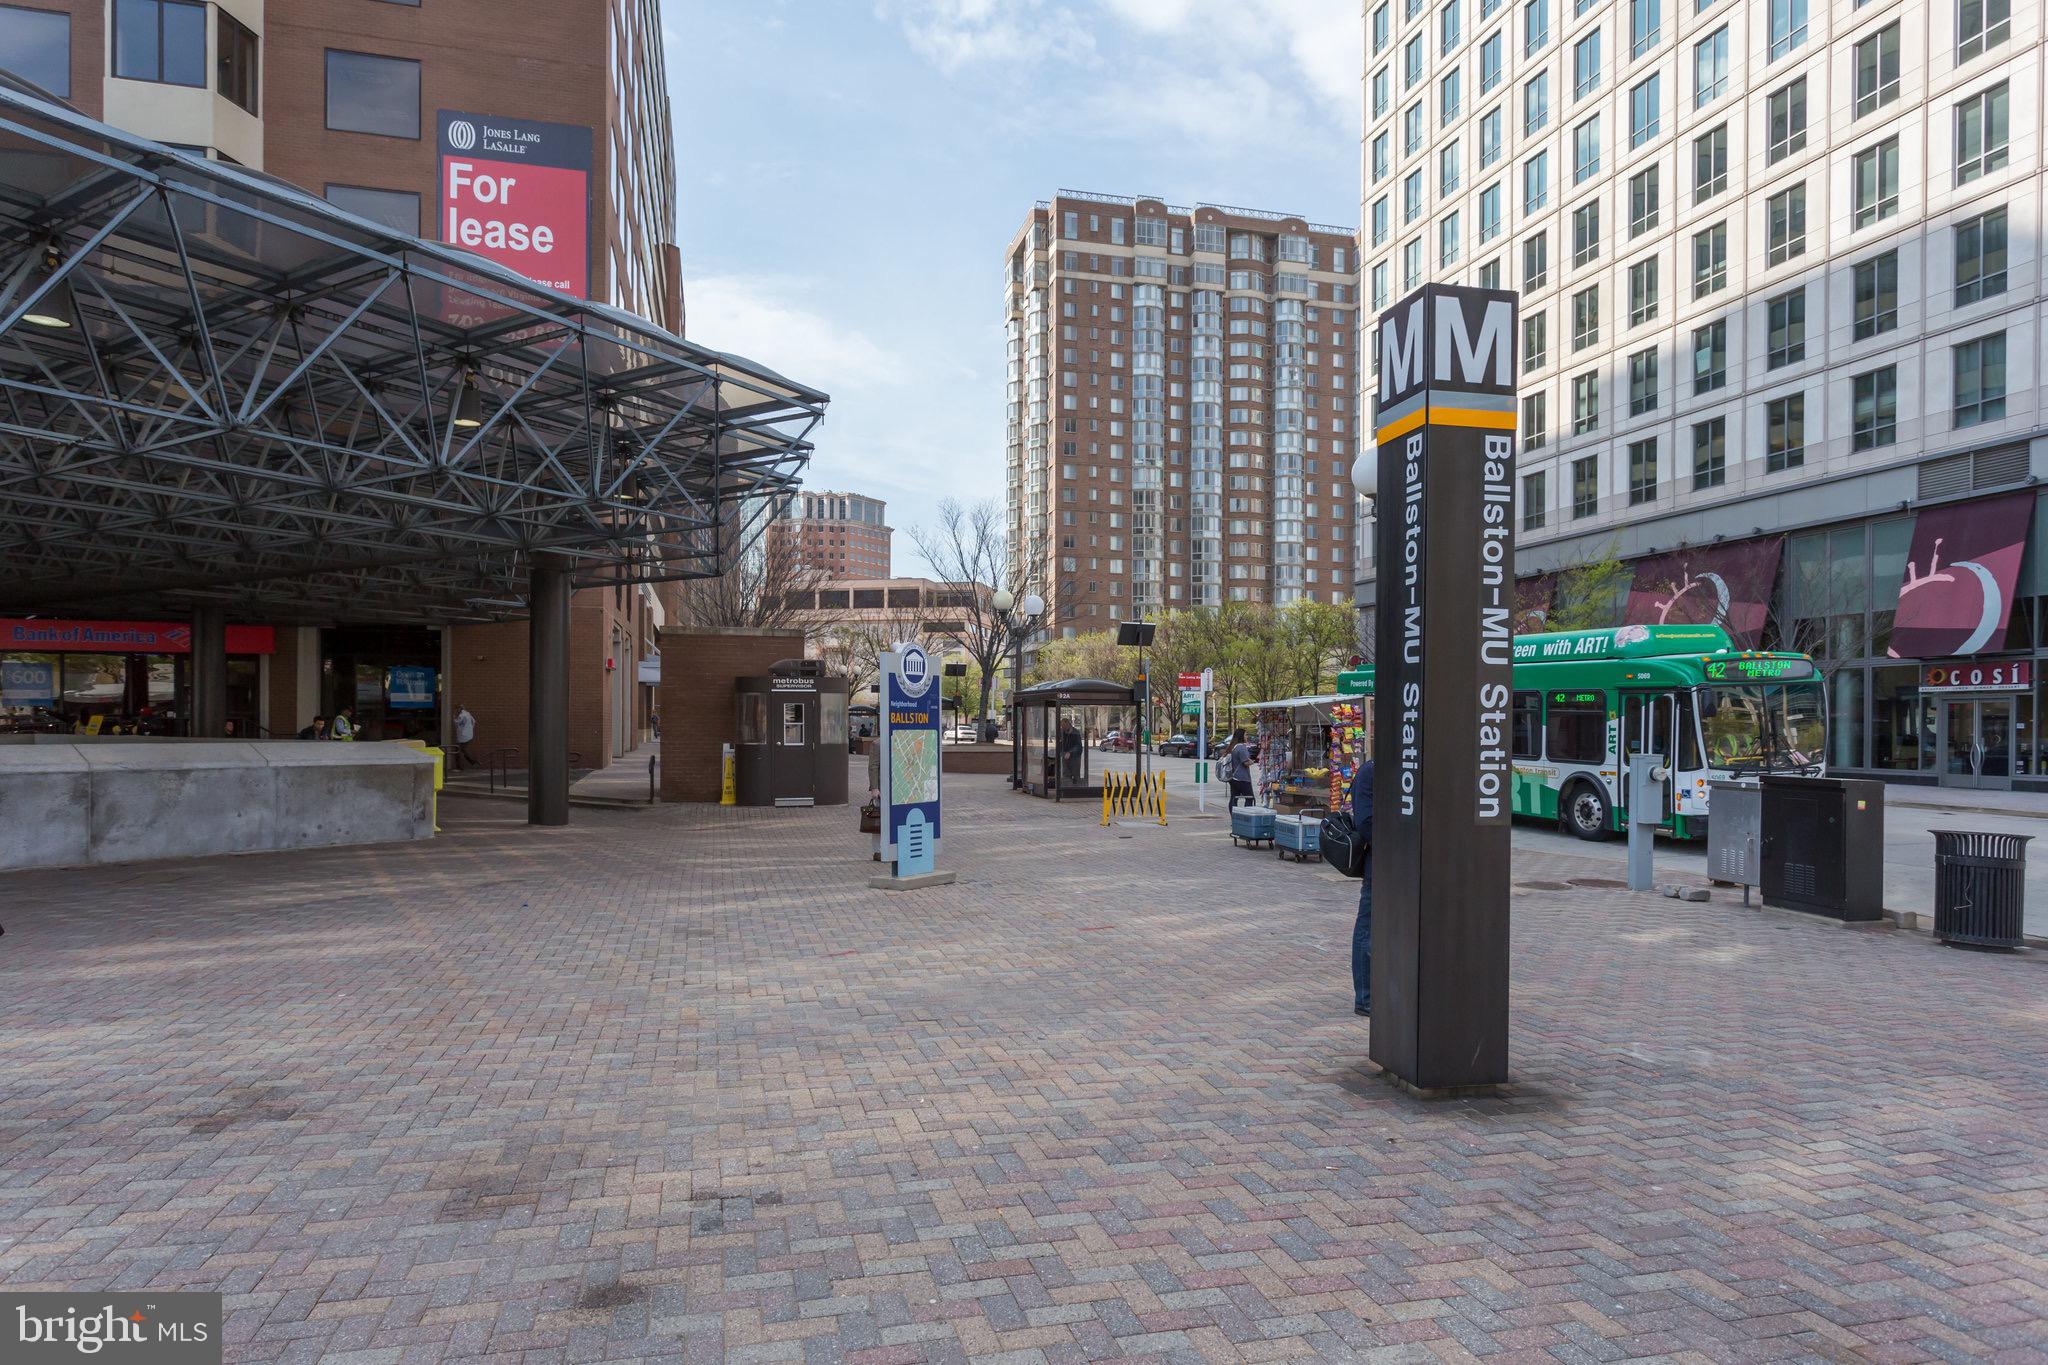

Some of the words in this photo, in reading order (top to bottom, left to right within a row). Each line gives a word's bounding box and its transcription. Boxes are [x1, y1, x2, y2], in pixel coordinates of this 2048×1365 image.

[450, 161, 516, 205] For
[450, 206, 554, 253] lease
[554, 279, 570, 290] call
[1381, 297, 1424, 404] M
[1434, 295, 1512, 386] M
[1403, 433, 1423, 664] Ballston-MU
[1481, 434, 1512, 665] Ballston-MU
[12, 625, 60, 641] Bank
[61, 627, 80, 642] of
[82, 628, 157, 645] America
[1543, 638, 1572, 657] with
[1574, 636, 1609, 654] ART!
[1707, 662, 1726, 678] 42
[1738, 661, 1791, 671] BALLSTON
[1747, 669, 1782, 677] METRO
[1555, 693, 1565, 703] 42
[1576, 694, 1595, 702] METRO
[890, 711, 929, 724] BALLSTON
[1401, 682, 1420, 816] Station
[1478, 683, 1509, 818] Station
[1608, 725, 1617, 755] ART
